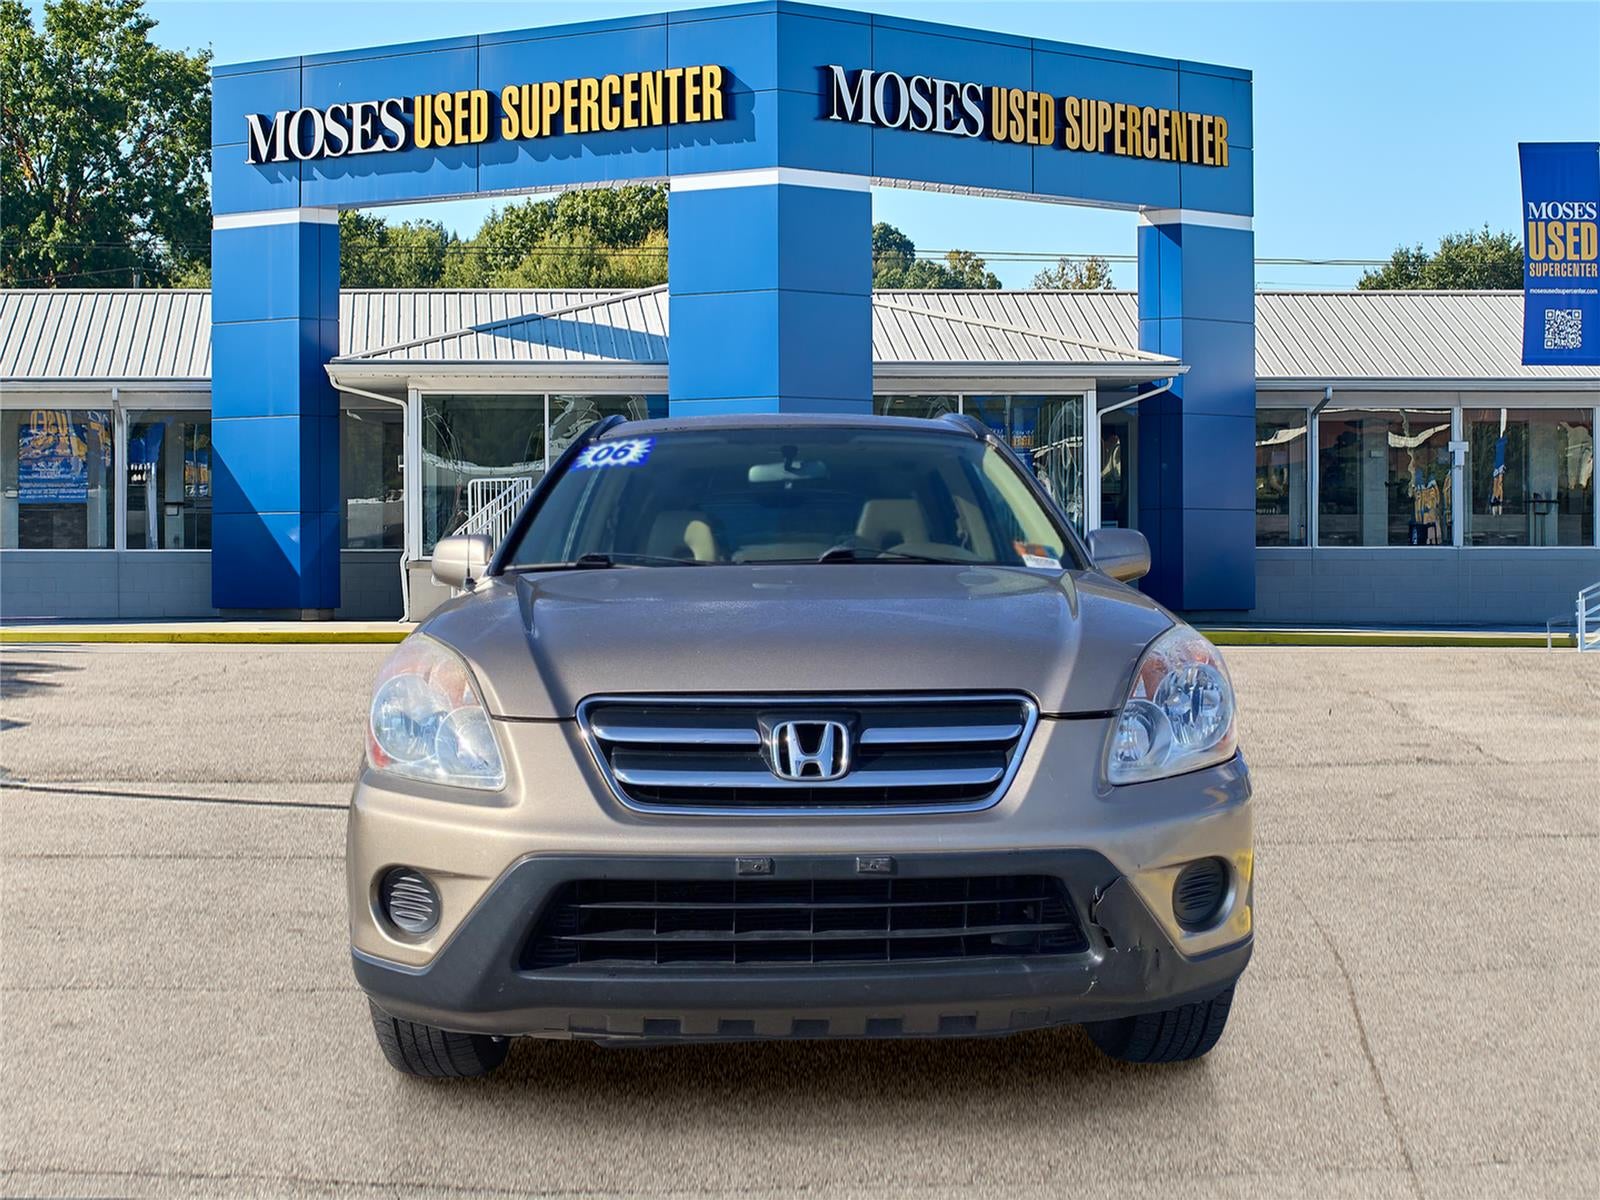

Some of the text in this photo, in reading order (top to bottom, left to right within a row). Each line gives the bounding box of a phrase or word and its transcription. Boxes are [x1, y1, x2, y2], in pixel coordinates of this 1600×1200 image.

[244, 64, 724, 164] MOSES USED SUPERCENTER
[829, 64, 1229, 167] MOSES USED SUPERCENTER
[1527, 201, 1597, 220] MOSES
[1528, 221, 1598, 261] USED
[1529, 262, 1598, 277] SUPERCENTER
[1529, 287, 1598, 295] mosesusedsupercenter.com
[591, 443, 635, 462] 06
